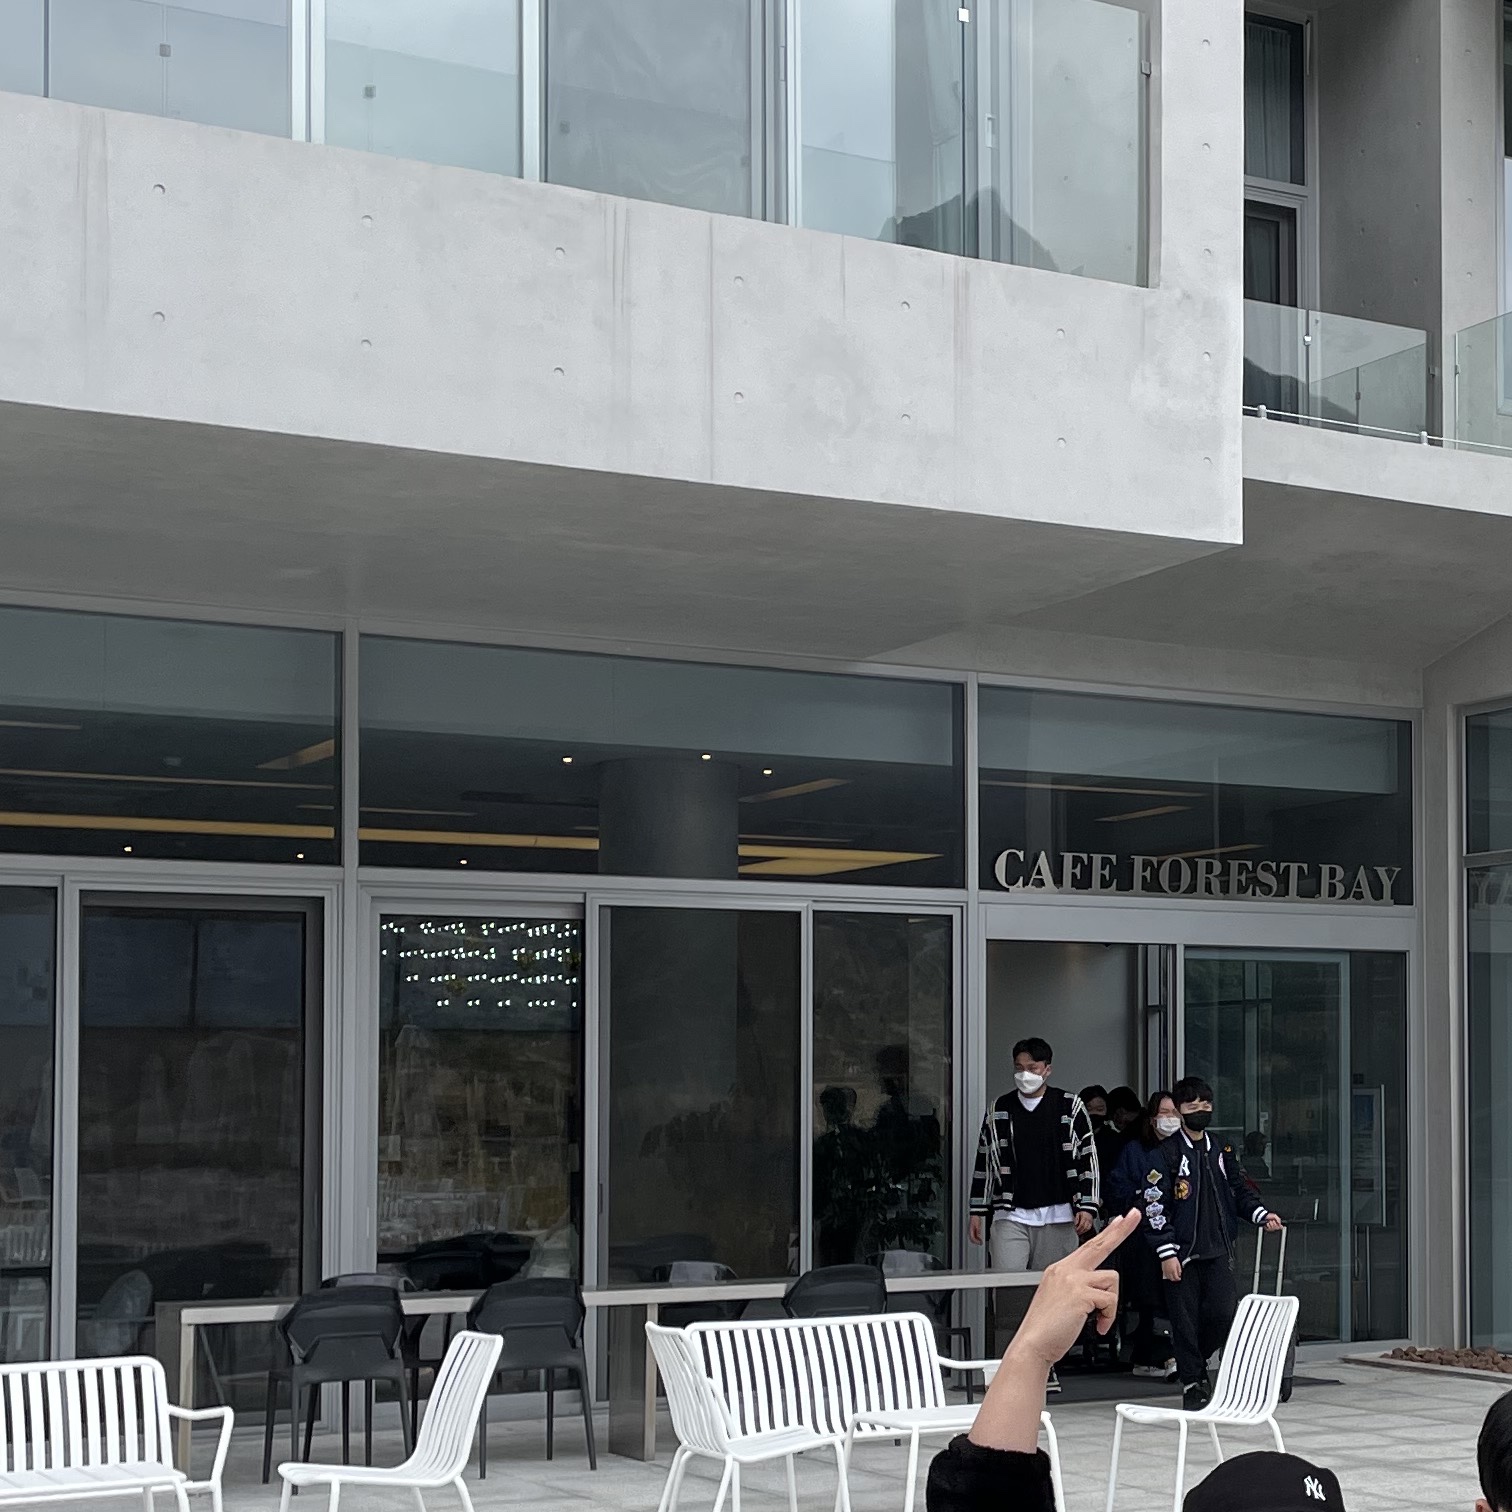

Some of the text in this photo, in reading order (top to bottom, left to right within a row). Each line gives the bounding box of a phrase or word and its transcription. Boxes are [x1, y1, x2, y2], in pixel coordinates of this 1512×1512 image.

[994, 848, 1402, 902] CAFE FOREST BAY
